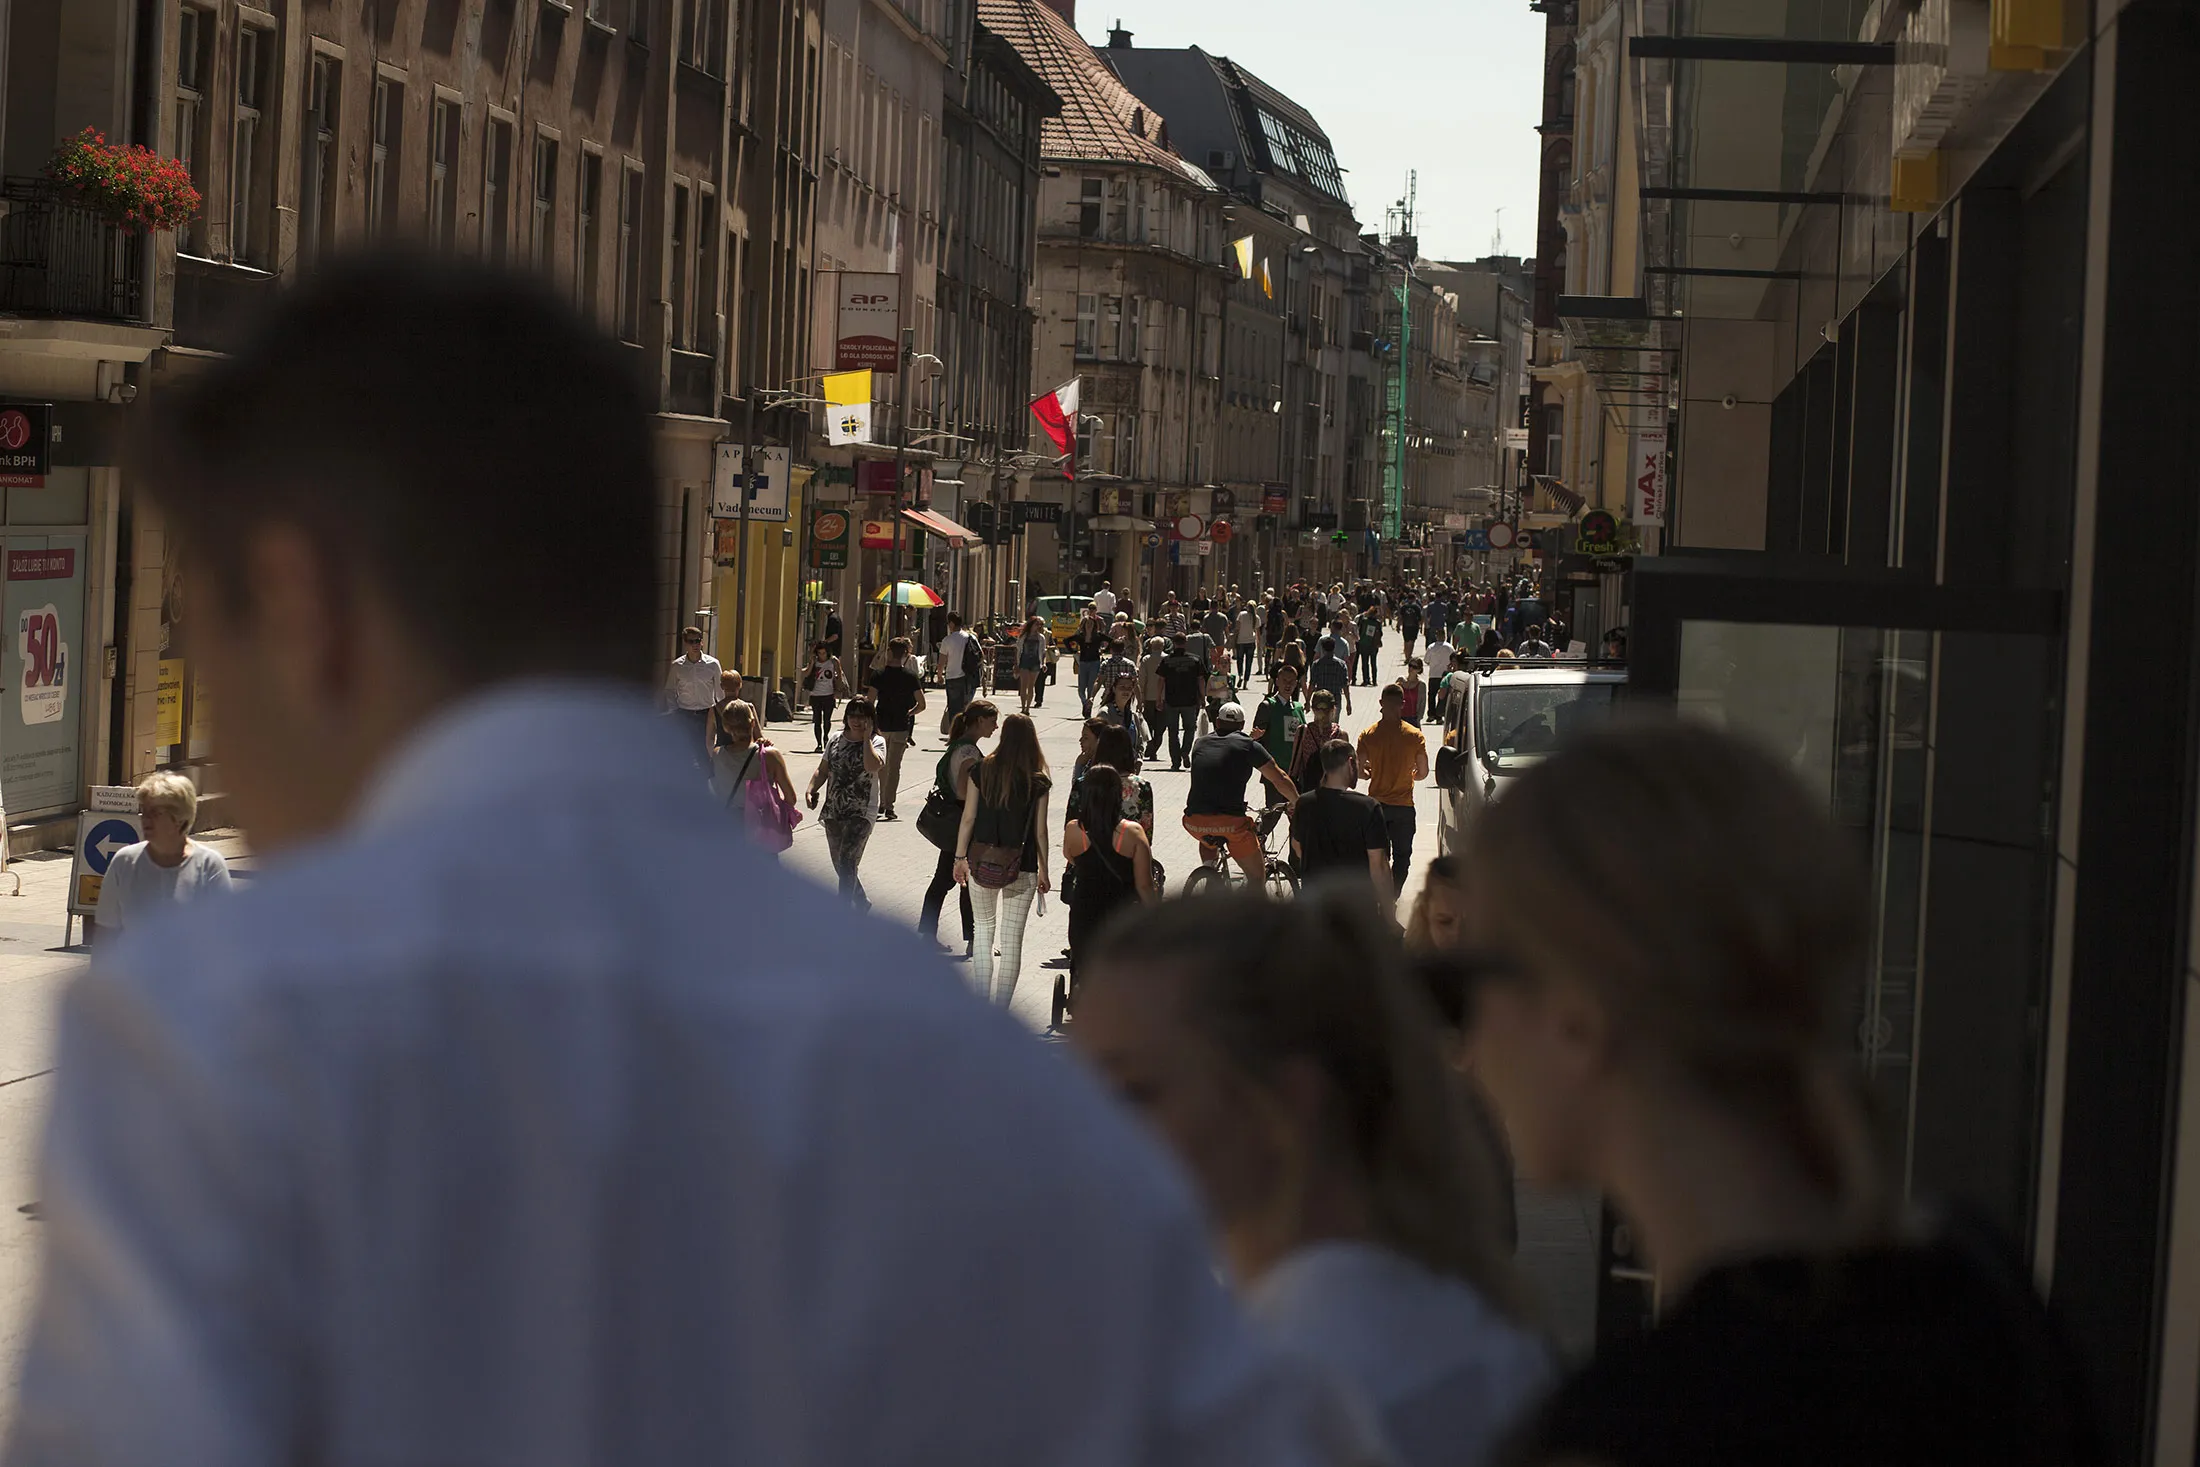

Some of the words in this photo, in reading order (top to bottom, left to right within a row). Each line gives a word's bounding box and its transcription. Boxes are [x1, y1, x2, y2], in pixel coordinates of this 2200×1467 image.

[13, 455, 36, 467] BPH
[721, 449, 784, 462] APKA
[819, 518, 839, 534] 24
[1582, 541, 1614, 552] Fresh
[1596, 560, 1616, 568] Fresh
[25, 613, 58, 688] 50
